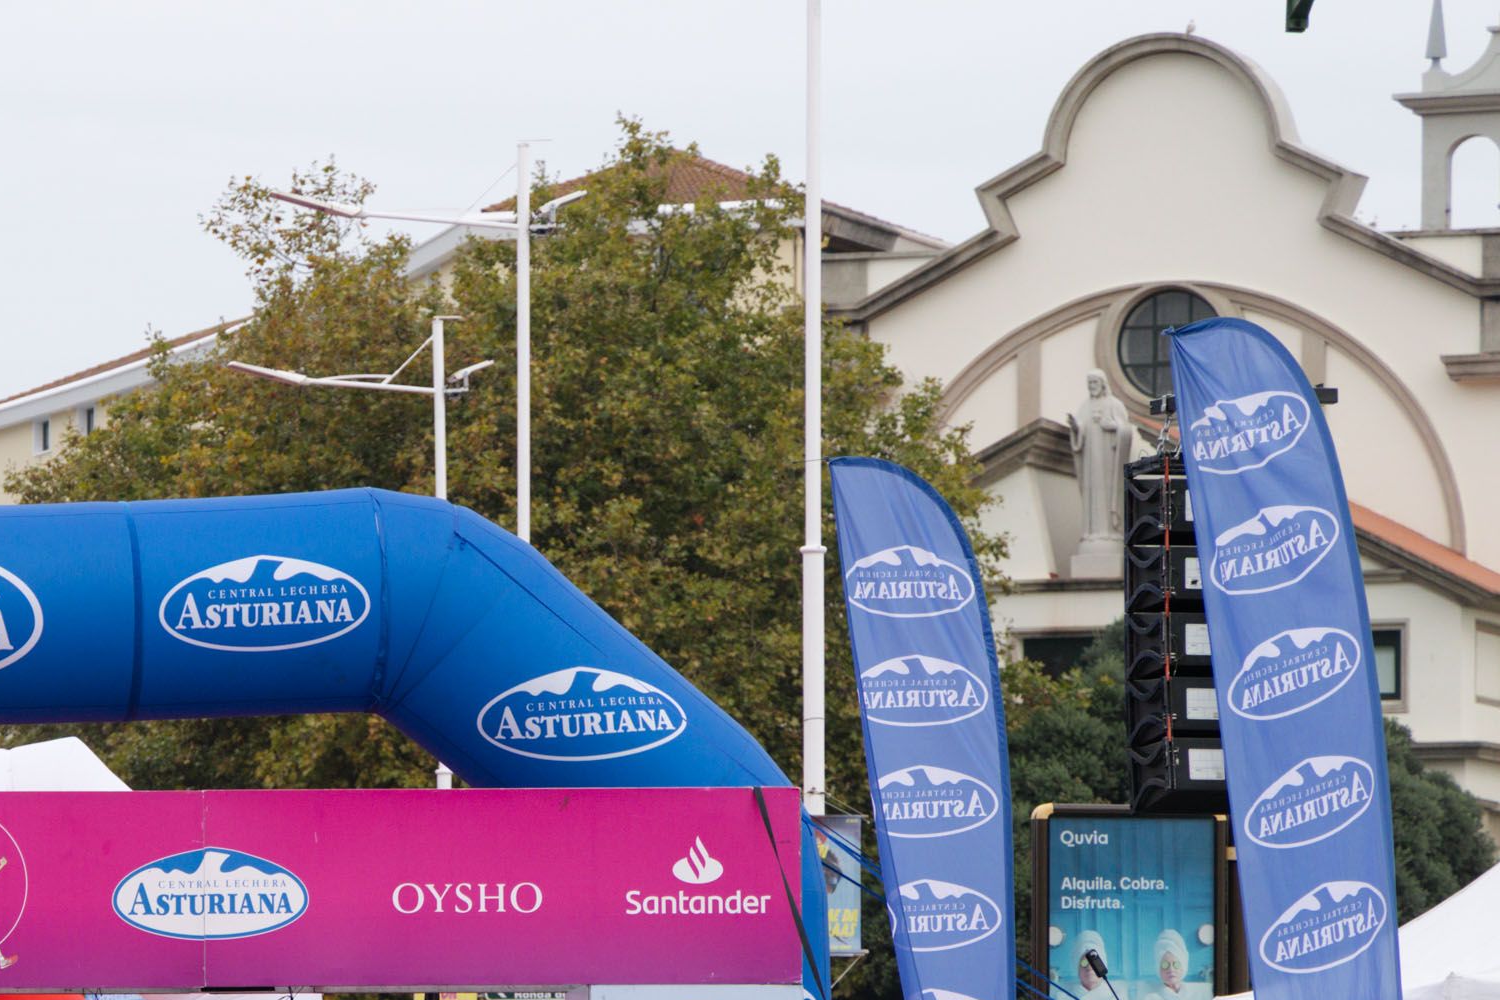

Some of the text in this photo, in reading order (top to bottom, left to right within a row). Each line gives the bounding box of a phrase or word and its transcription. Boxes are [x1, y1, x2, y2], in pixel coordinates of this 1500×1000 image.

[207, 584, 348, 600] CENTRAL LECHERA
[175, 592, 355, 631] ASTURIANA
[526, 696, 663, 712] CENTRAL LECHERA
[494, 705, 677, 740] ASTURIANA
[1060, 830, 1109, 848] Quvia
[158, 879, 288, 890] CENTRAL LECHERA
[1060, 876, 1170, 894] Alquila. Cobra.
[128, 882, 295, 917] ASTURIANA
[392, 883, 543, 914] OYSHO
[625, 889, 772, 916] Santander
[1061, 895, 1125, 910] Disfruta.
